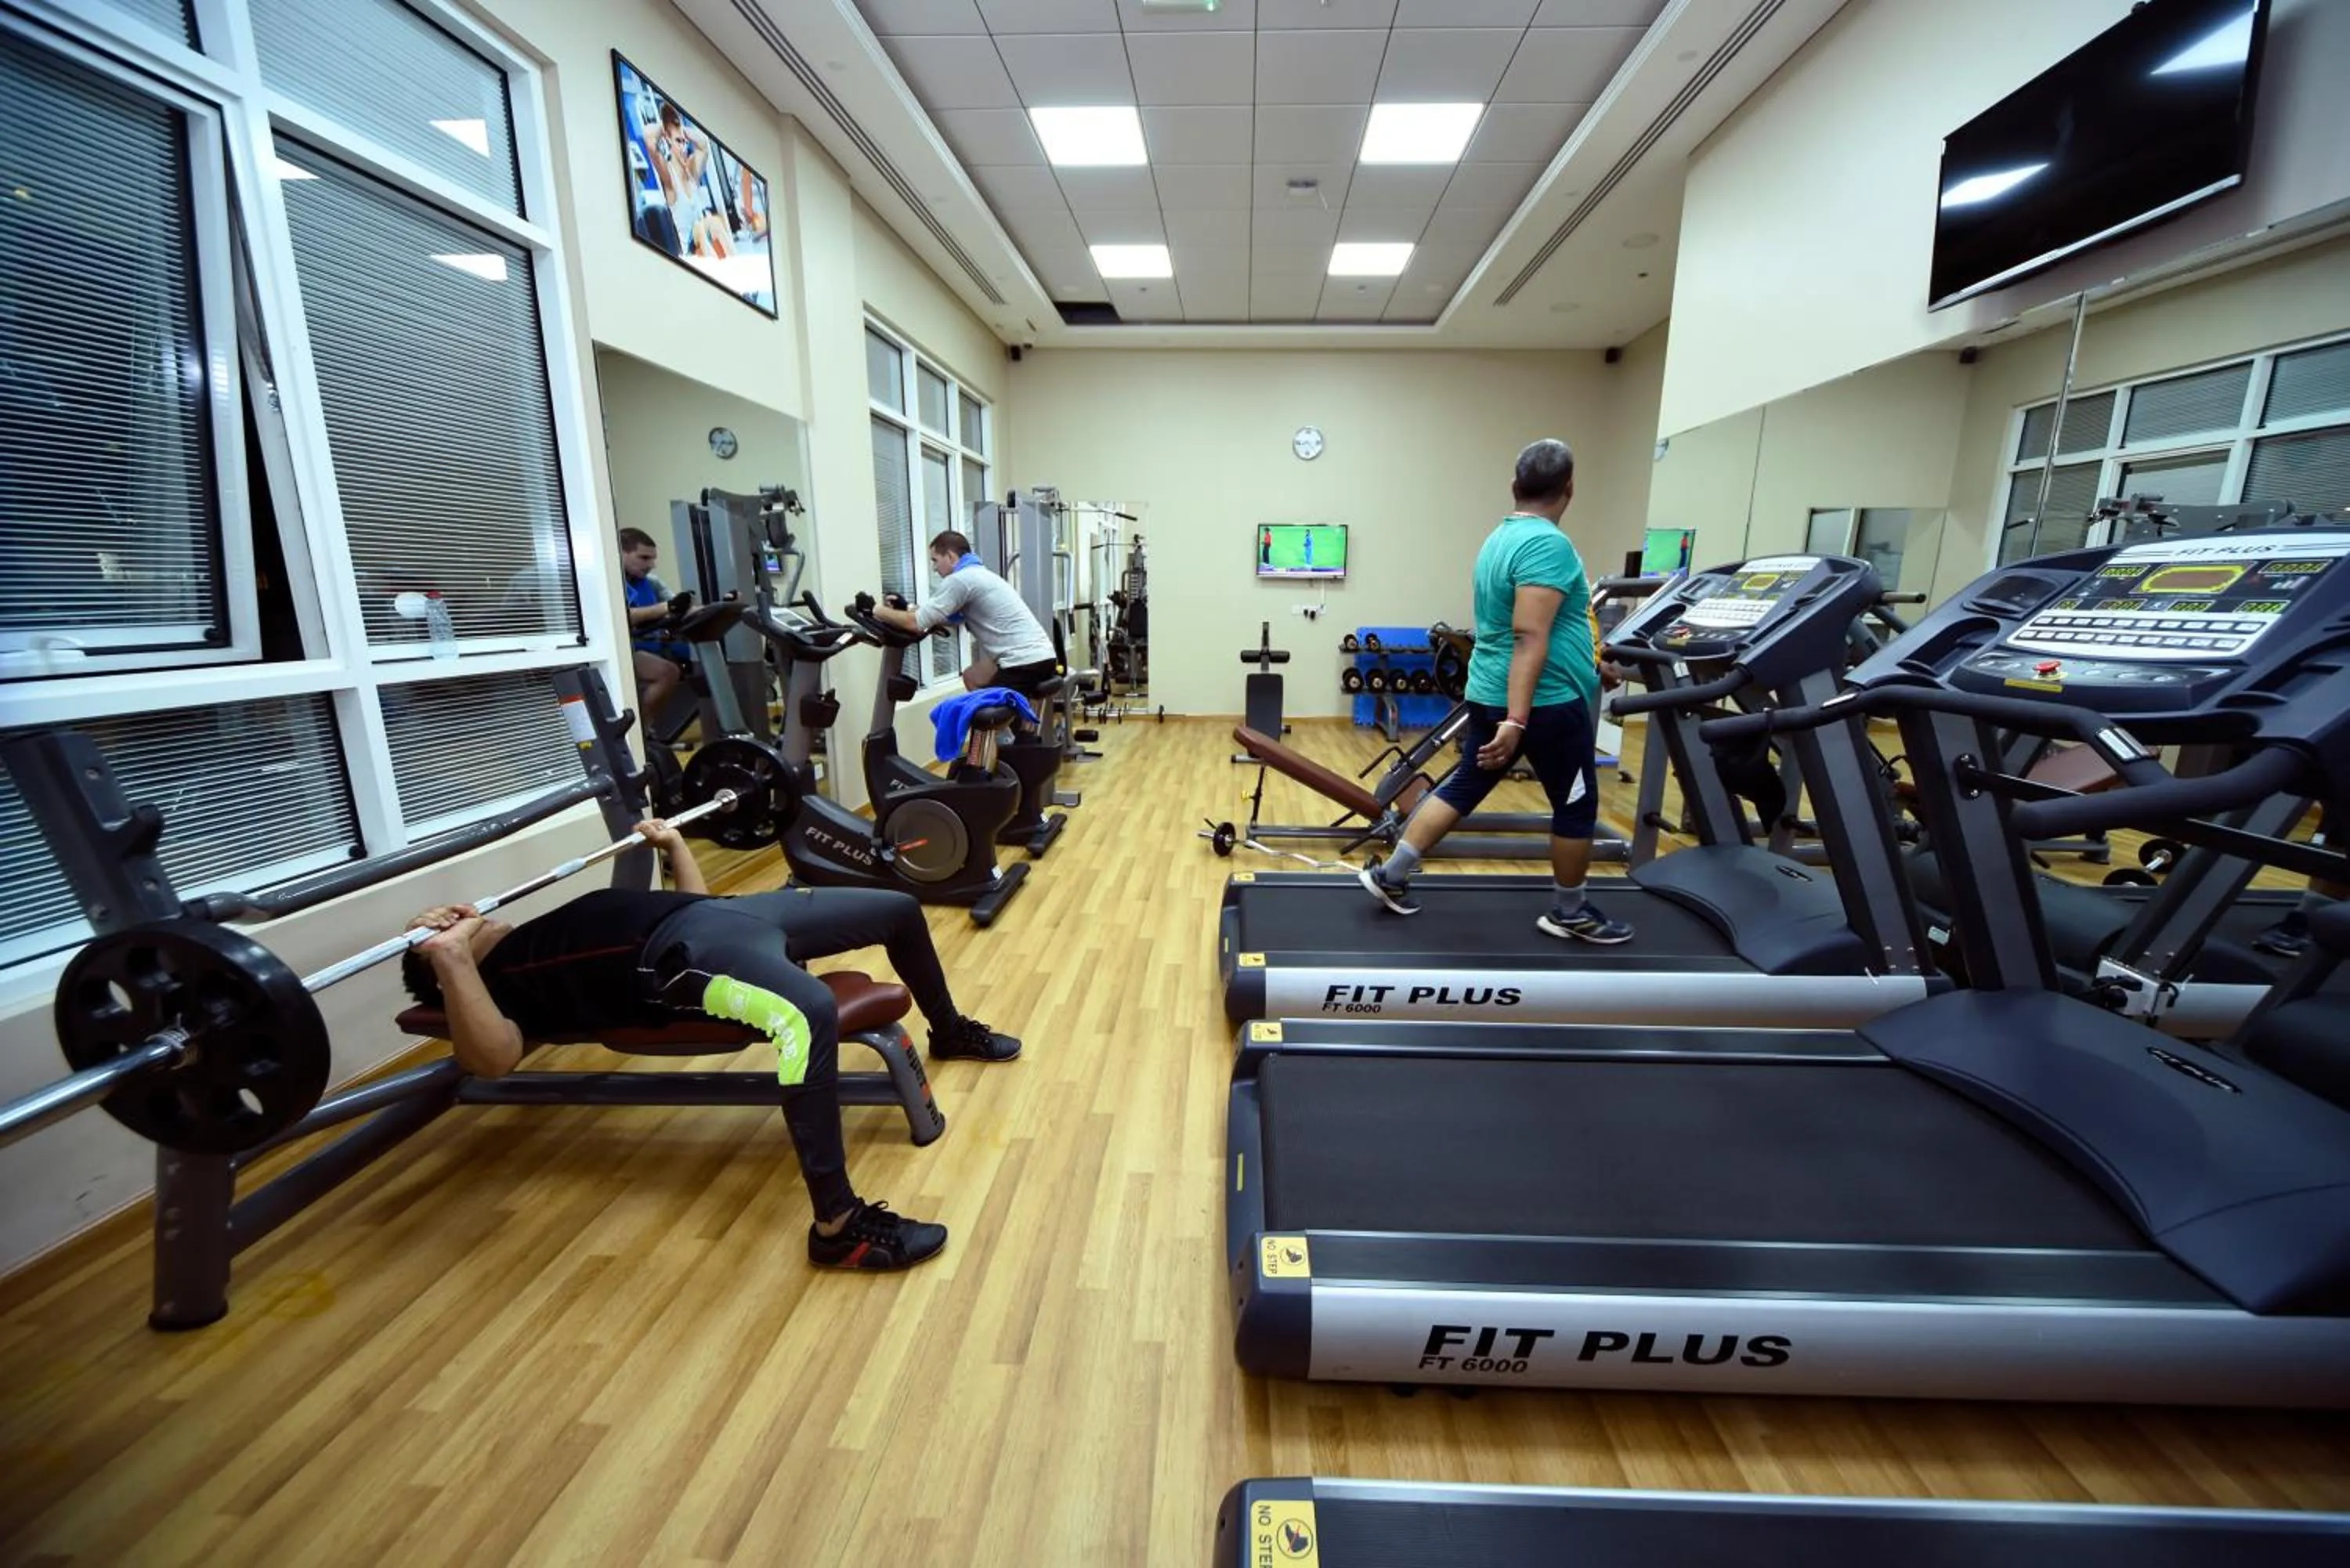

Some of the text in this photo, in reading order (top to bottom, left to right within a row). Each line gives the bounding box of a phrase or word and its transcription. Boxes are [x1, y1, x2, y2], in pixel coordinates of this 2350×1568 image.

[804, 826, 873, 865] FIT PLUS
[1325, 985, 1522, 1006] FIT PLUS
[1322, 1002, 1382, 1013] FT 6000
[1267, 1253, 1278, 1275] STEP
[1422, 1324, 1792, 1367] FIT PLUS
[1418, 1355, 1528, 1374] FT 6000
[1258, 1505, 1271, 1526] NO
